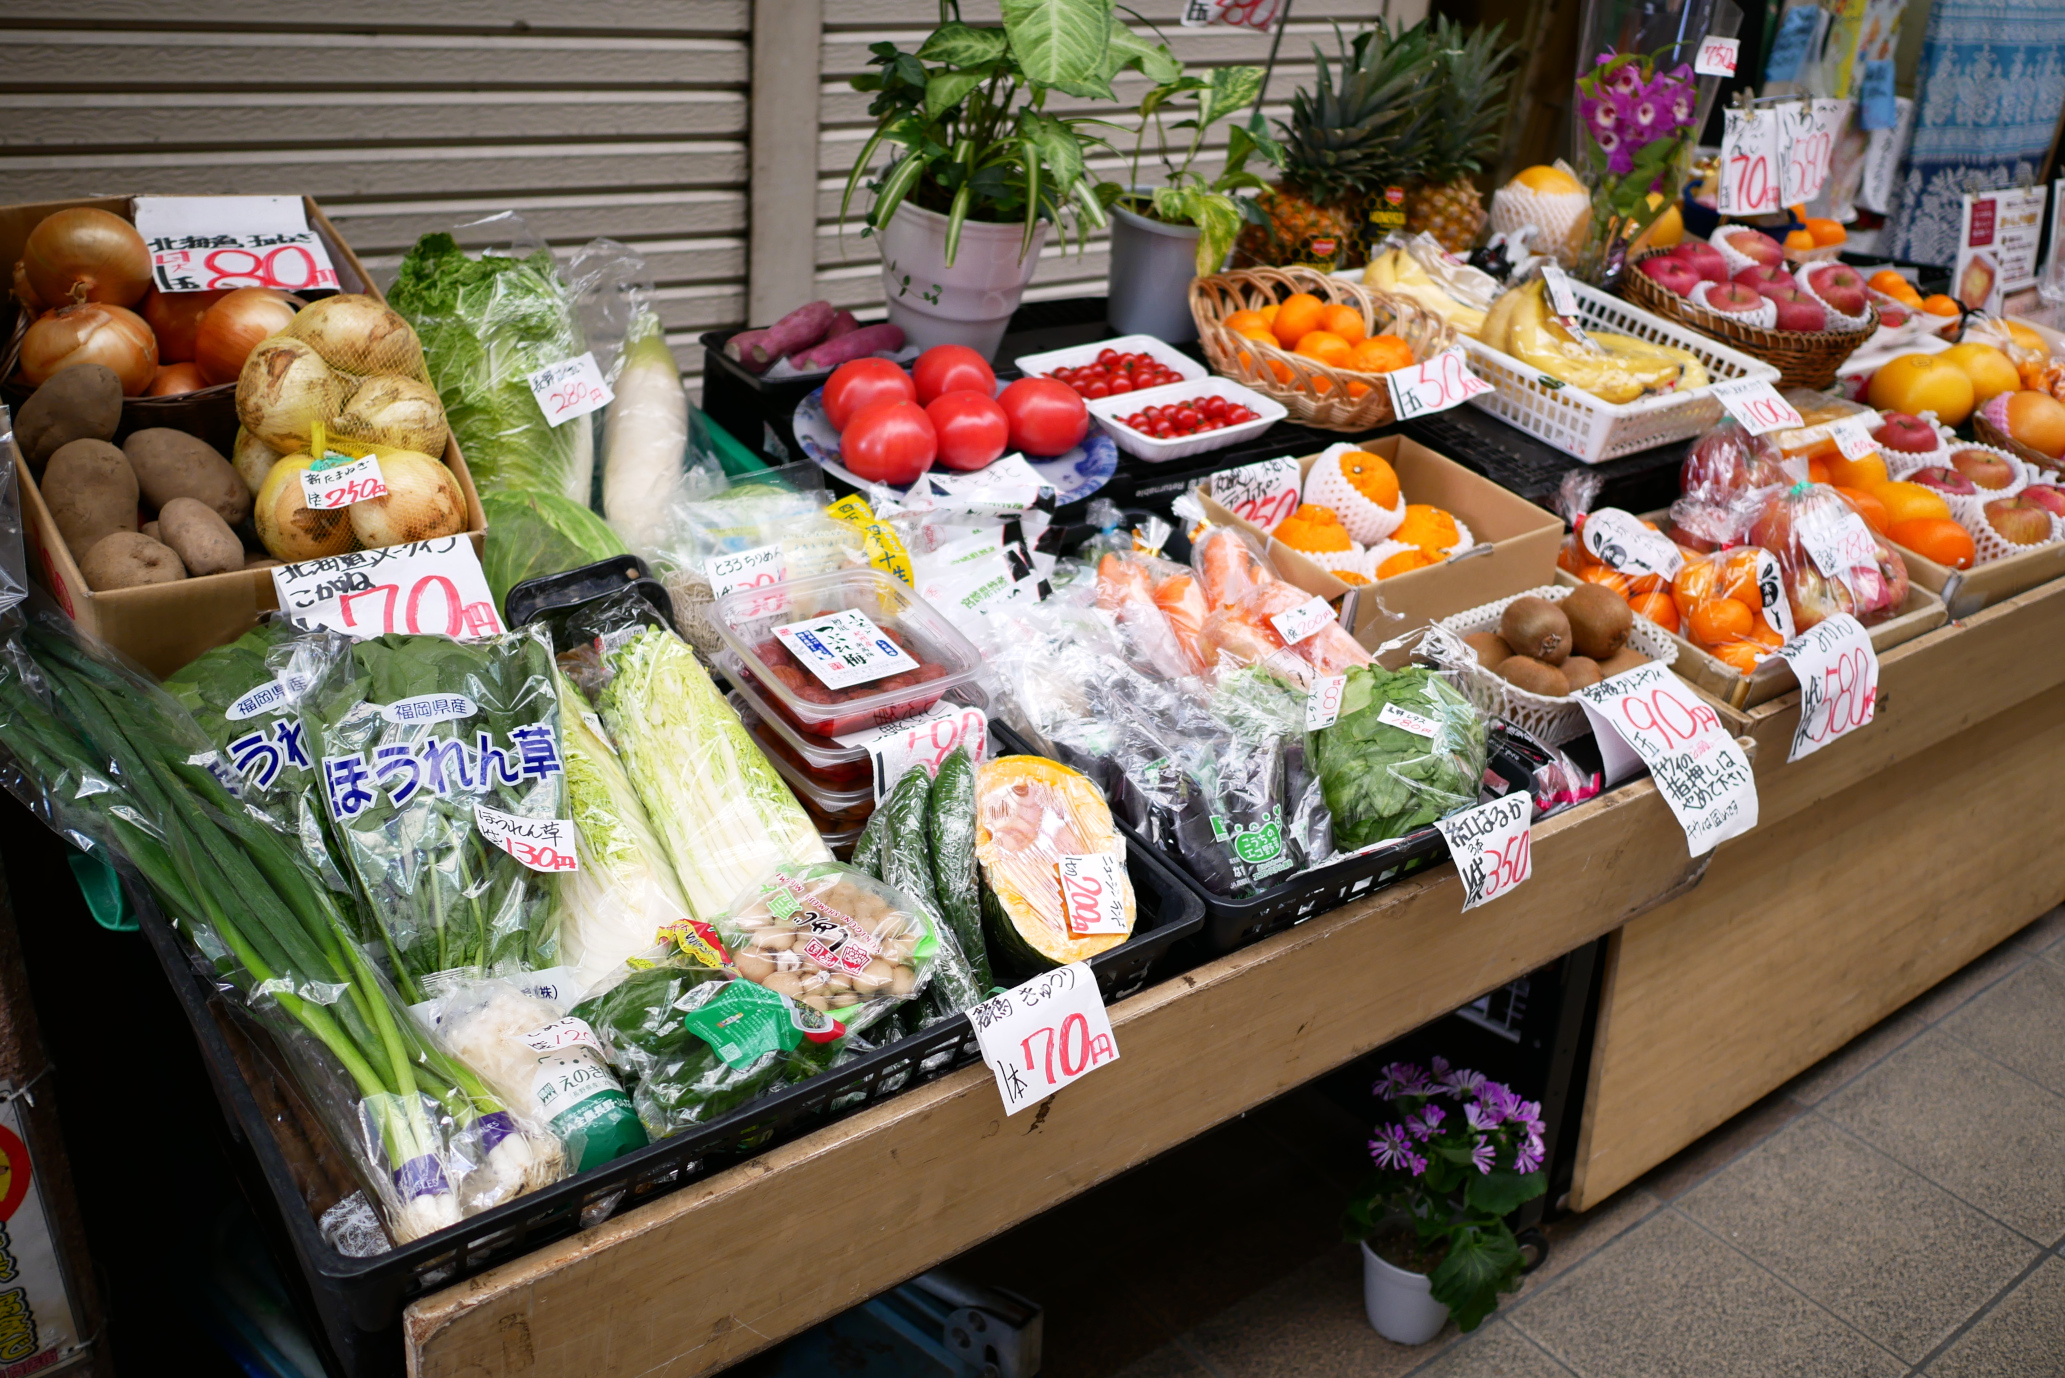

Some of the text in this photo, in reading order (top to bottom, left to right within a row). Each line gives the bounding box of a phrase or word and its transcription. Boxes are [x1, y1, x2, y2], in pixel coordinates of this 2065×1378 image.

[549, 381, 606, 414] 280円
[1418, 353, 1490, 408] 50円
[324, 477, 387, 508] 250円
[338, 575, 501, 637] 70円
[393, 698, 468, 719] 福岡県産
[1622, 689, 1720, 750] 90円
[325, 724, 561, 821] ほうれん草
[479, 807, 563, 849] ほうれん草
[504, 836, 578, 871] 130円
[1483, 829, 1529, 896] 350
[1063, 873, 1103, 933] 200円
[1019, 967, 1076, 1007] きゅうり
[1020, 1012, 1114, 1085] 70円
